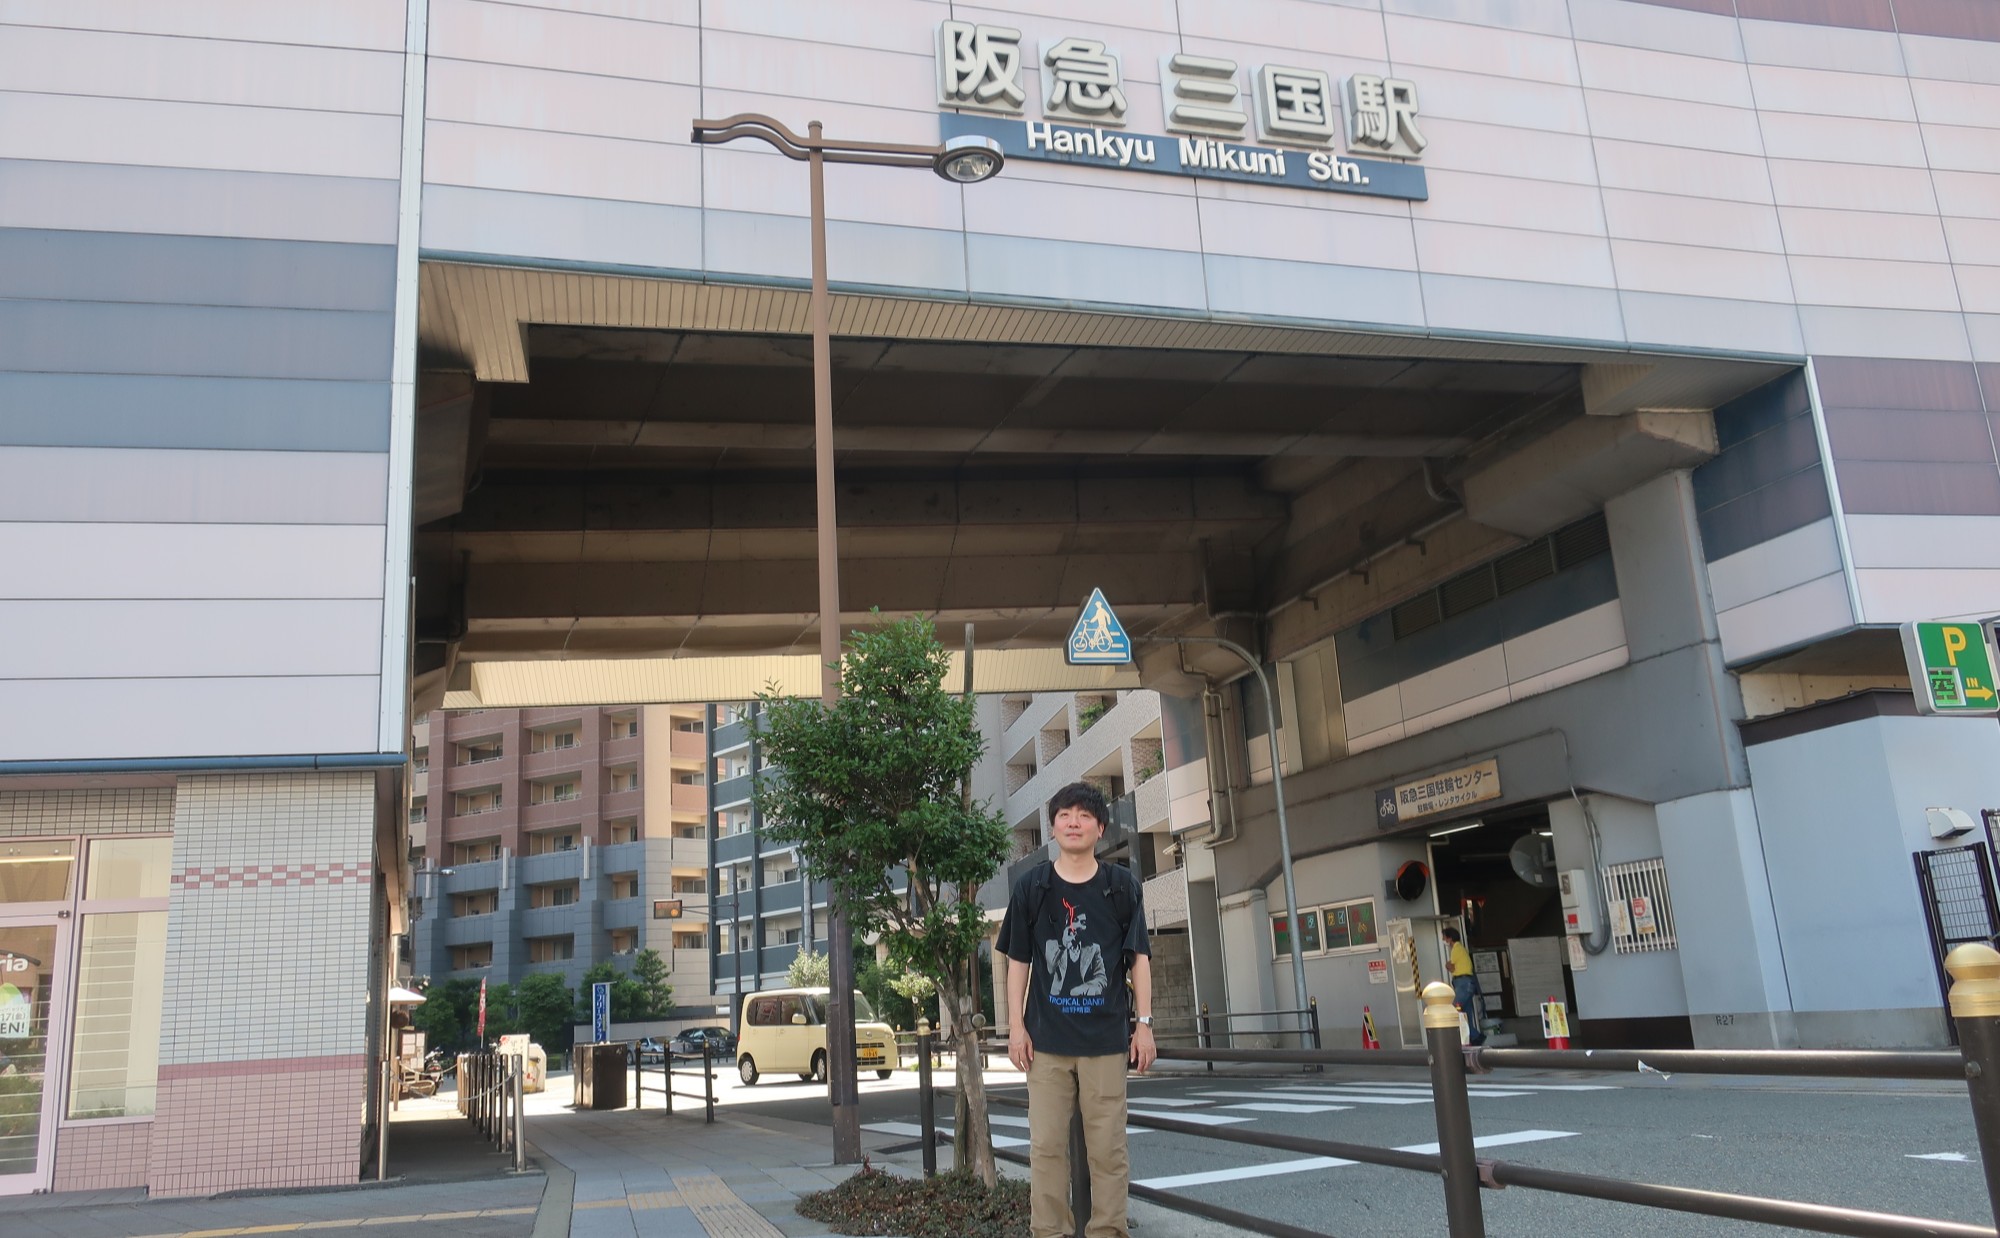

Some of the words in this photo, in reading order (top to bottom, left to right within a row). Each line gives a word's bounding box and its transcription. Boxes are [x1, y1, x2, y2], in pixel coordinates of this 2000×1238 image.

[940, 20, 1428, 154] 阪急三国駅
[1025, 120, 1156, 167] Hankyu
[1178, 137, 1286, 177] Mikuni
[1307, 151, 1370, 185] Stn.
[1942, 626, 1967, 666] P
[1929, 669, 1960, 705] 空
[1966, 677, 1979, 688] IN
[1400, 770, 1493, 806] 阪急三国駐輪センター
[1049, 995, 1080, 1006] TROPICAL
[1715, 1015, 1734, 1026] R27
